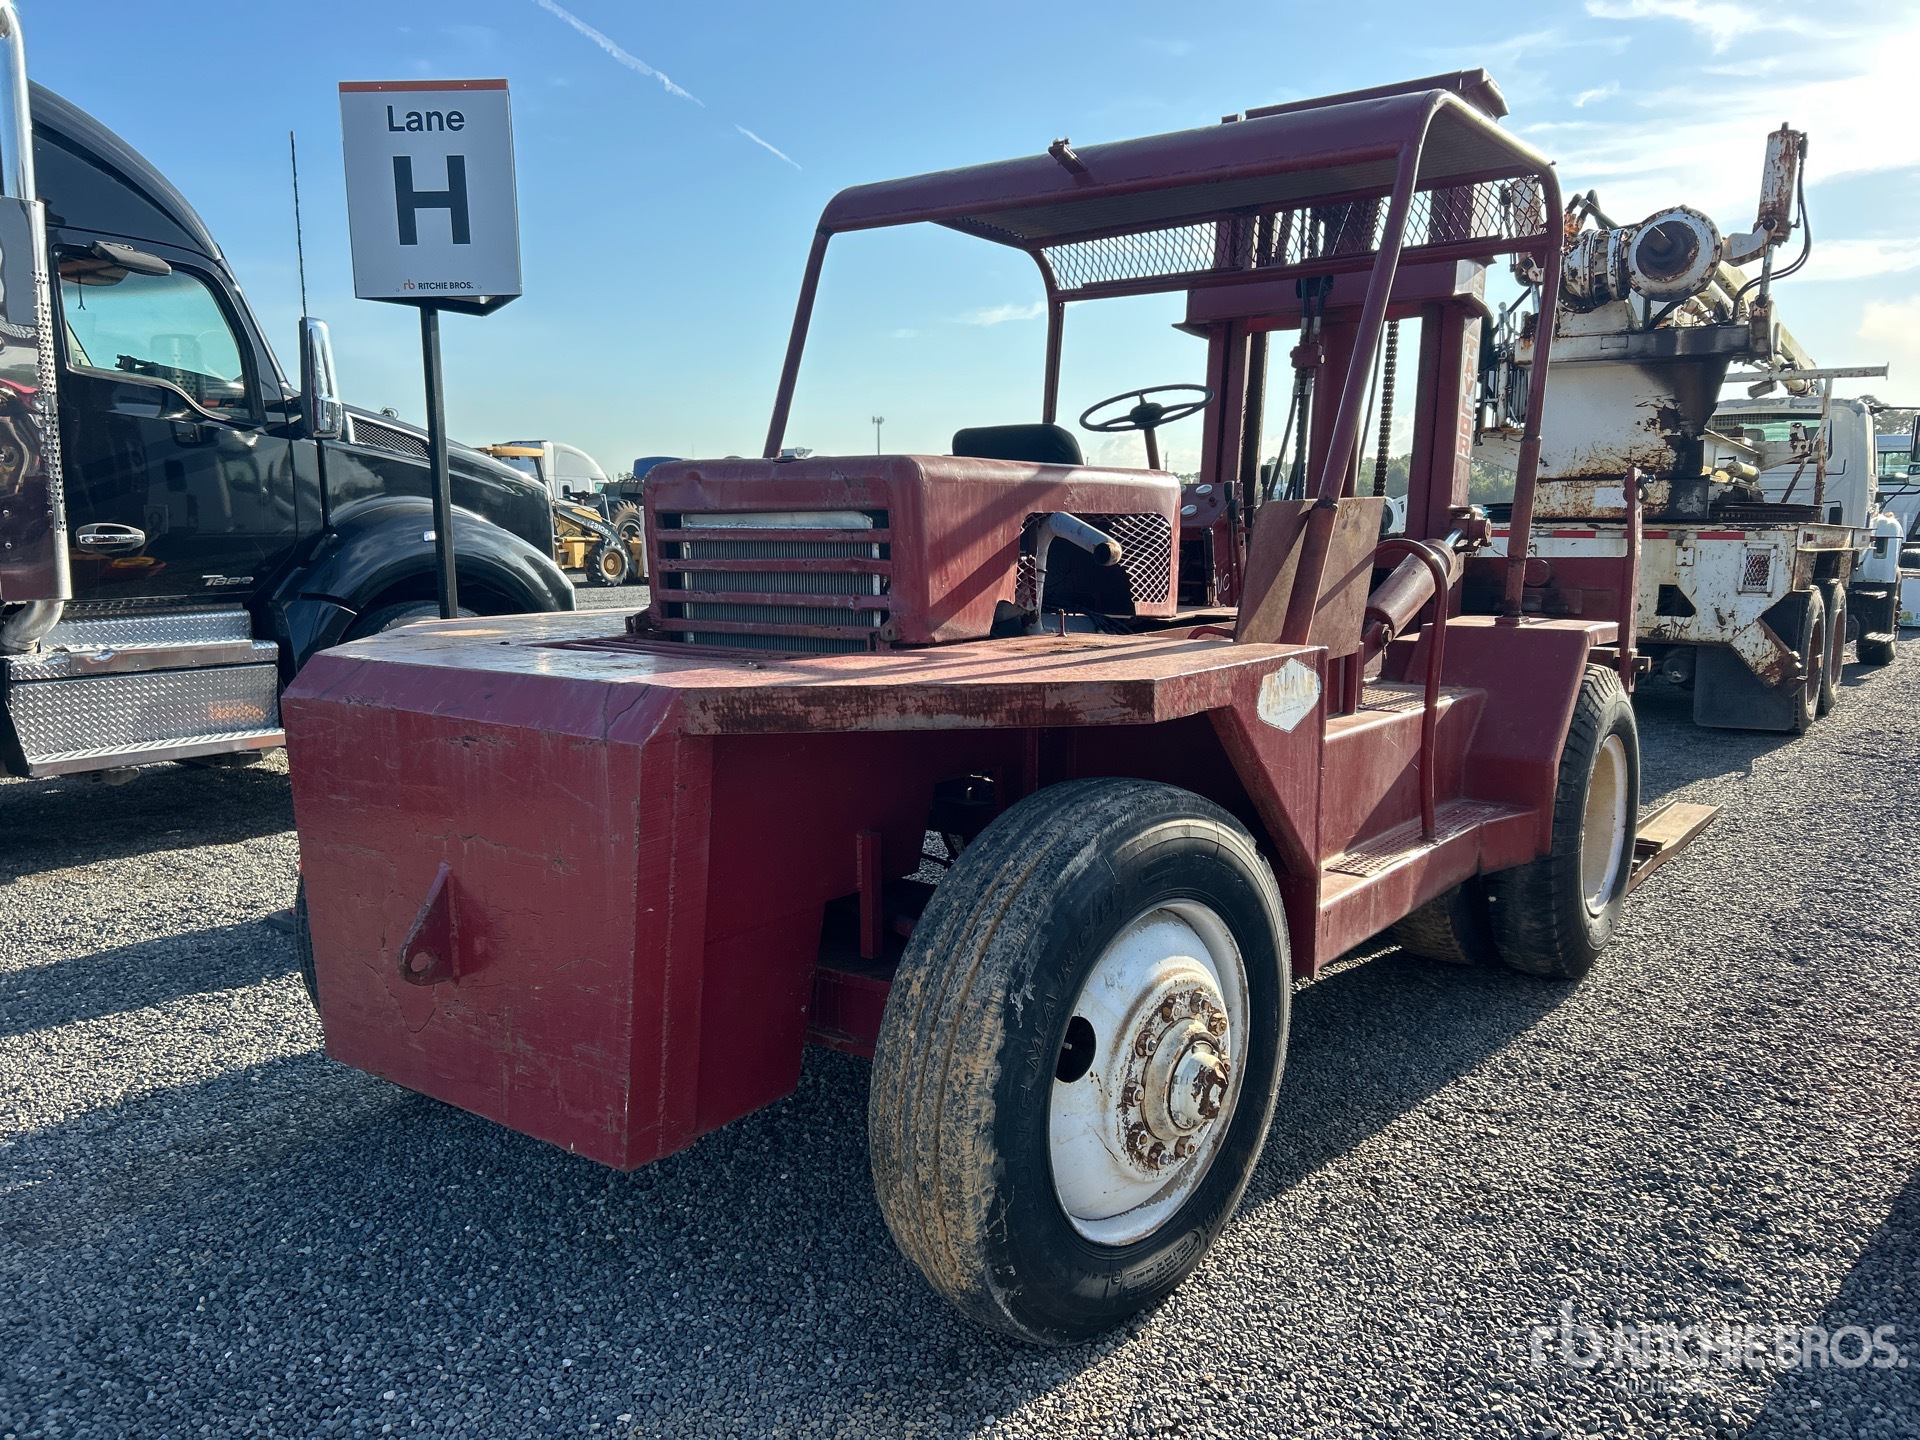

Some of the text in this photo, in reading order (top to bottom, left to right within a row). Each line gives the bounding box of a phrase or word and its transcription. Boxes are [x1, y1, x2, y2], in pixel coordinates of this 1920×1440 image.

[387, 105, 465, 132] Lane
[393, 155, 471, 245] H
[418, 282, 448, 290] RITCHIE
[449, 281, 474, 290] BROS.
[1458, 334, 1478, 457] TAYLOR
